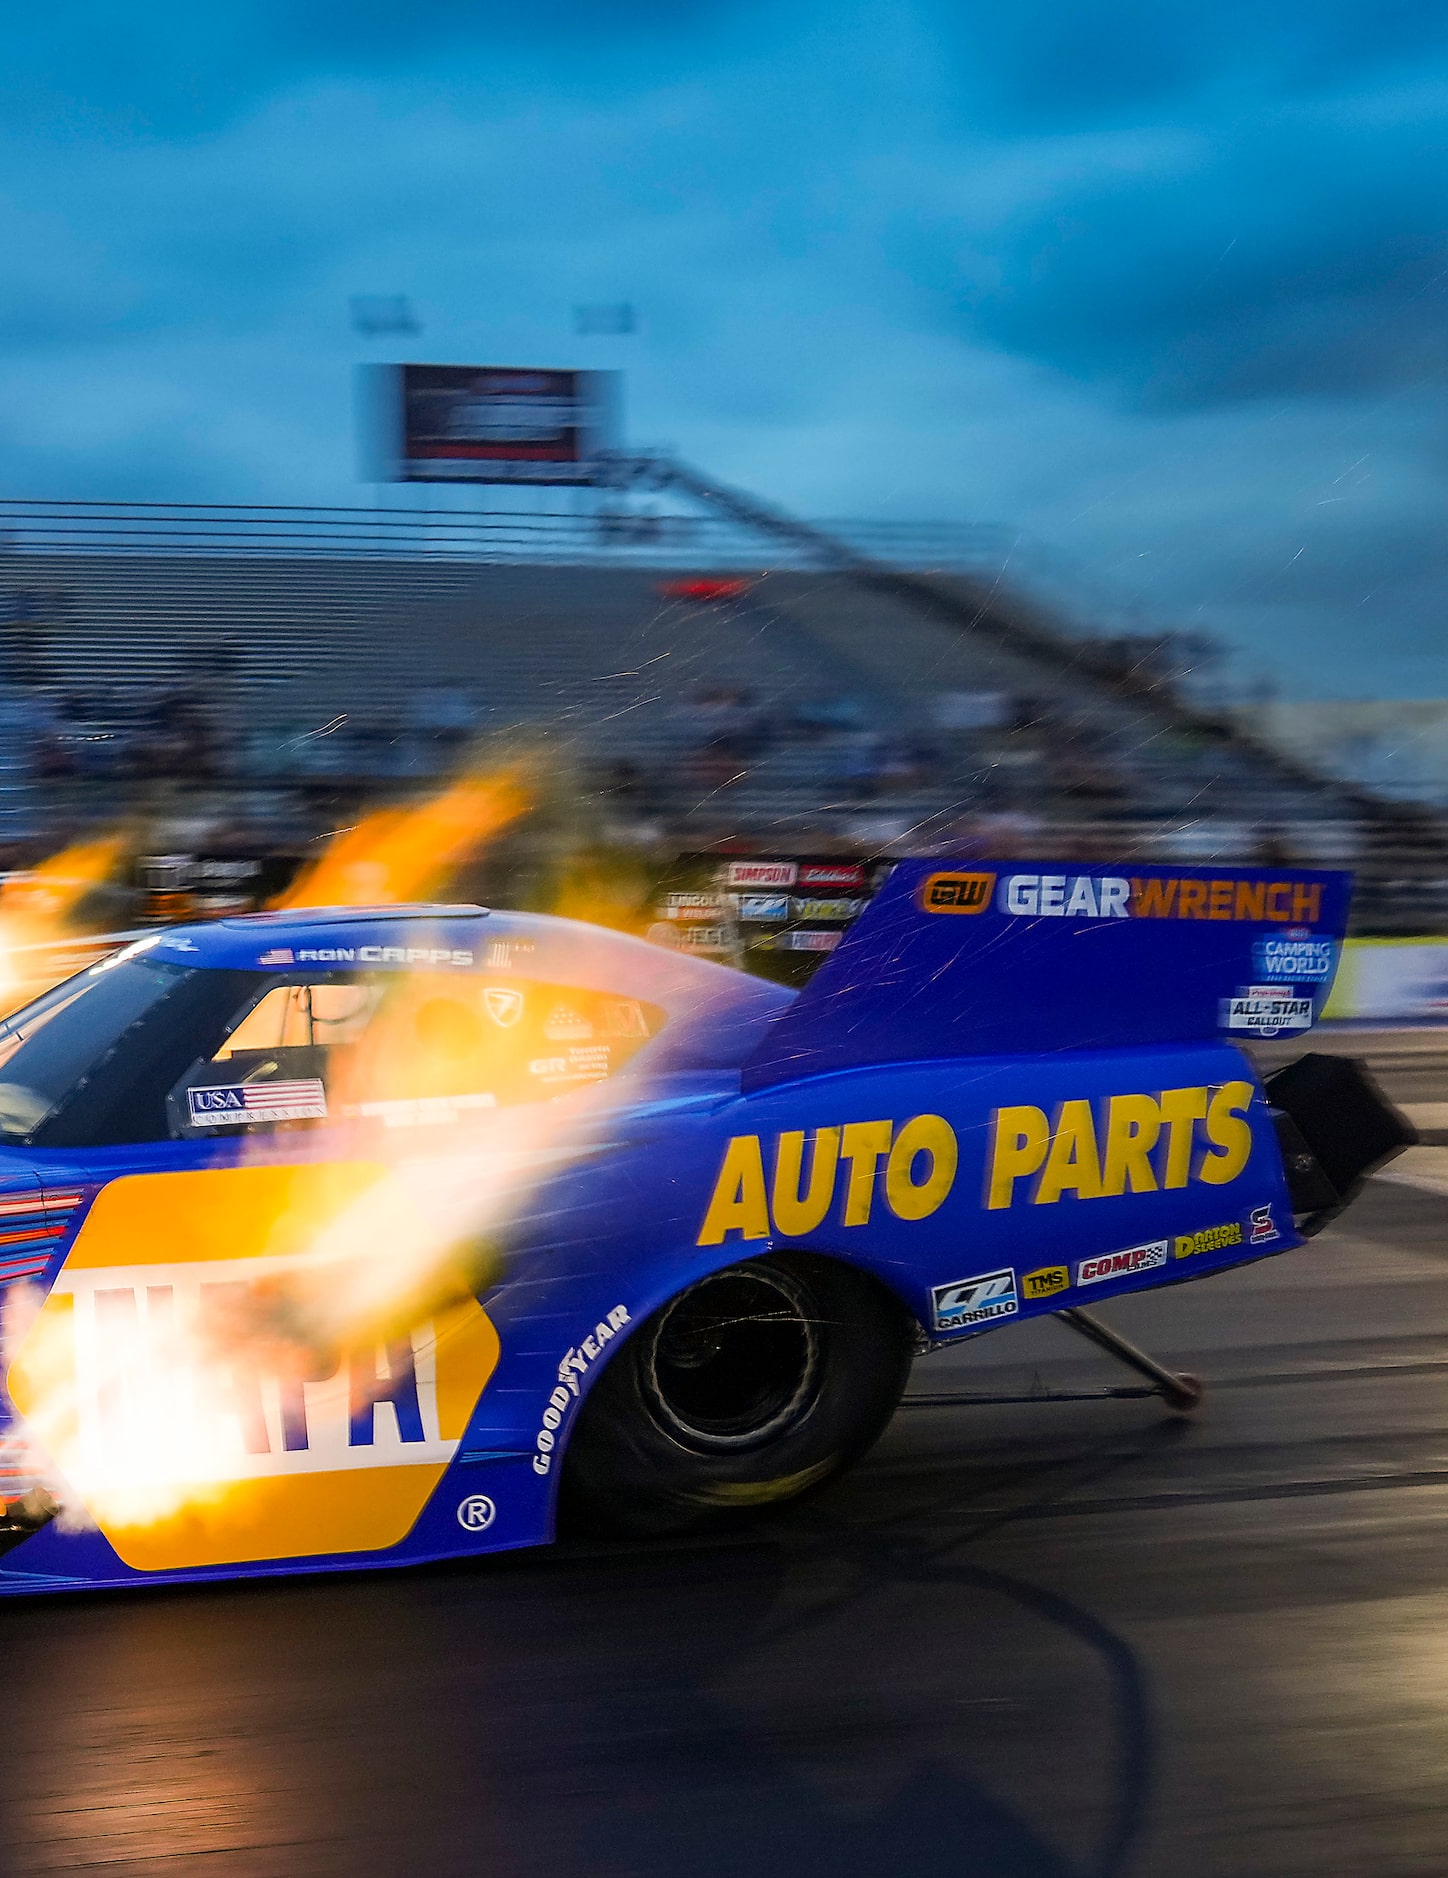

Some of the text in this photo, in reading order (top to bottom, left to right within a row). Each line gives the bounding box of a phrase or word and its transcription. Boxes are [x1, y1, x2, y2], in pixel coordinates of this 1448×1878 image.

[735, 867, 791, 881] SIMPSON
[930, 879, 988, 907] GW
[1007, 874, 1321, 922] GEARWRENCH
[298, 948, 355, 962] RON
[359, 945, 474, 966] CAPPS
[1265, 941, 1330, 956] CAMPING
[1265, 956, 1330, 974] WORLD
[1232, 1001, 1310, 1015] ALL-STAR
[1247, 1016, 1292, 1026] CALLOUT
[196, 1090, 242, 1110] USA
[696, 1080, 1255, 1247] AUTO PARTS
[1175, 1222, 1242, 1259] DARTON
[1193, 1234, 1243, 1255] SLEEVES
[1082, 1249, 1147, 1279] COMP
[1028, 1270, 1064, 1291] TMS
[1030, 1283, 1065, 1296] TITANIUM
[938, 1301, 1017, 1330] CARRILLO
[532, 1304, 632, 1475] GOODYEAR
